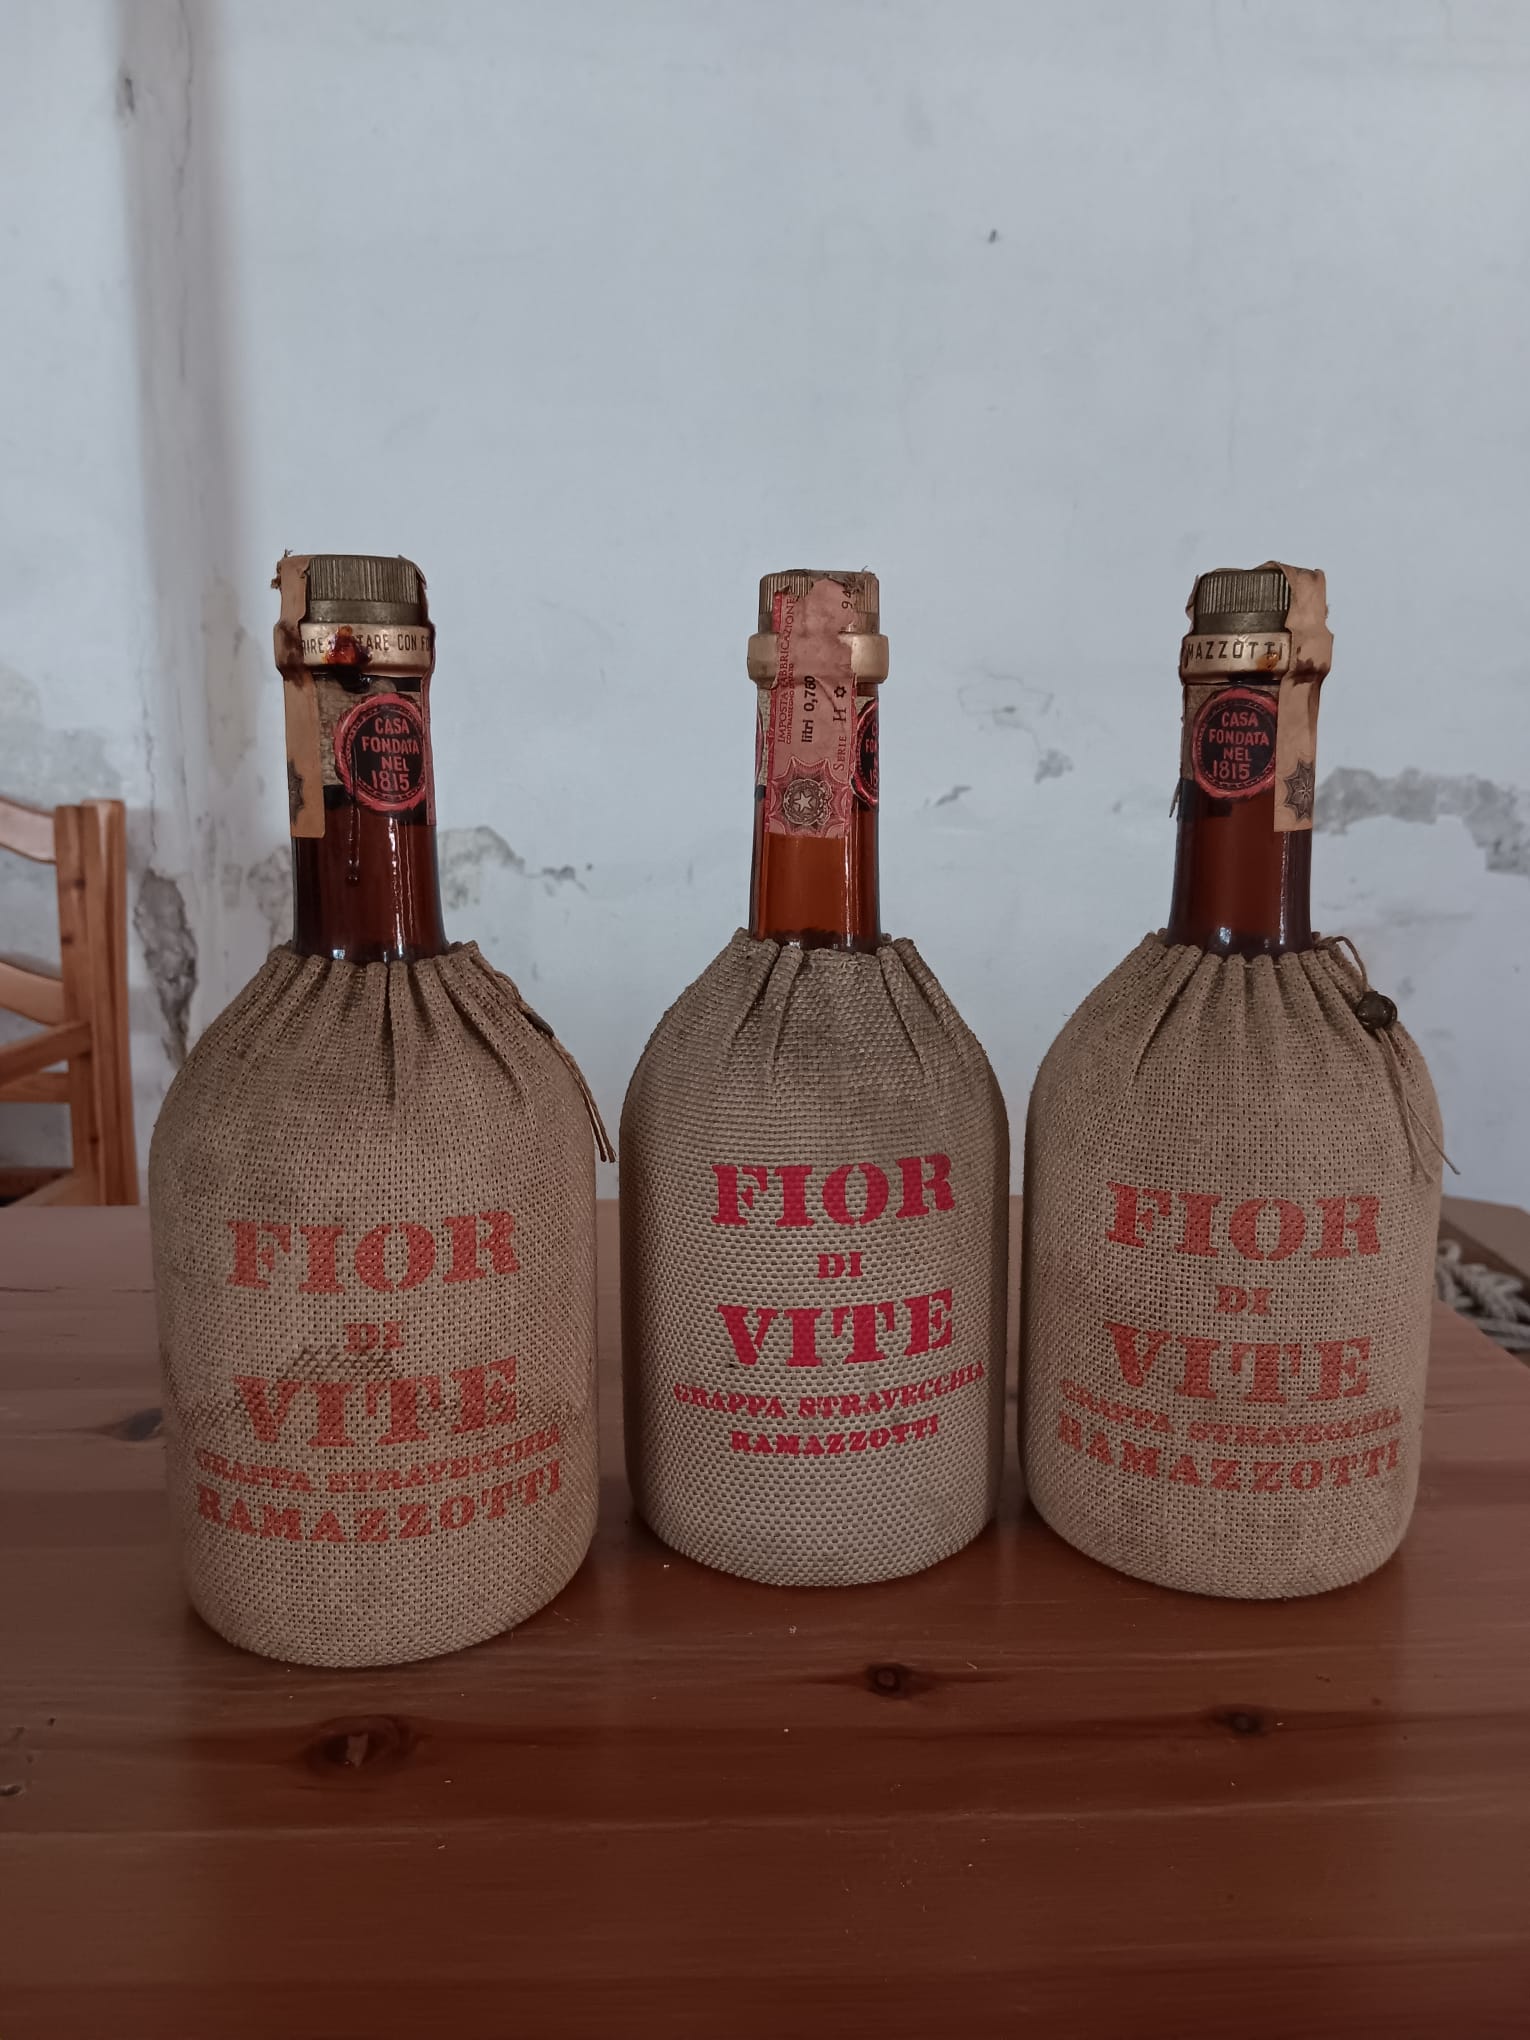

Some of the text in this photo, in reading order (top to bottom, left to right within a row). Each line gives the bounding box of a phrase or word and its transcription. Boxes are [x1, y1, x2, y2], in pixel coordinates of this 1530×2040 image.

[397, 634, 417, 651] CON
[375, 717, 410, 735] CASA
[801, 720, 815, 743] litri
[1222, 711, 1259, 728] CASA
[361, 736, 420, 755] FONDATA
[1208, 728, 1270, 747] FONDATA
[1223, 746, 1252, 762] NEL
[381, 755, 410, 772] NEL
[1213, 759, 1250, 780] 1815
[371, 770, 410, 792] 1815
[711, 1153, 955, 1228] FIOR
[1105, 1181, 1382, 1262] FIOR
[227, 1210, 520, 1294] FIOR
[817, 1251, 863, 1279] DI
[1213, 1285, 1273, 1315] DI
[343, 1320, 405, 1353] DI
[717, 1288, 953, 1367] VITE
[1104, 1322, 1372, 1404] VITE
[233, 1356, 519, 1447] VITE
[674, 1360, 985, 1419] GRAPPA STRAVECCHIA
[731, 1414, 939, 1455] RAMAZZOTTI
[1188, 1405, 1402, 1446] STRAVECCHIA
[327, 1423, 561, 1493] STRAVECCHIA
[1058, 1410, 1401, 1492] RAMAZZOTTI
[196, 1460, 562, 1543] RAMAZZOTTI
